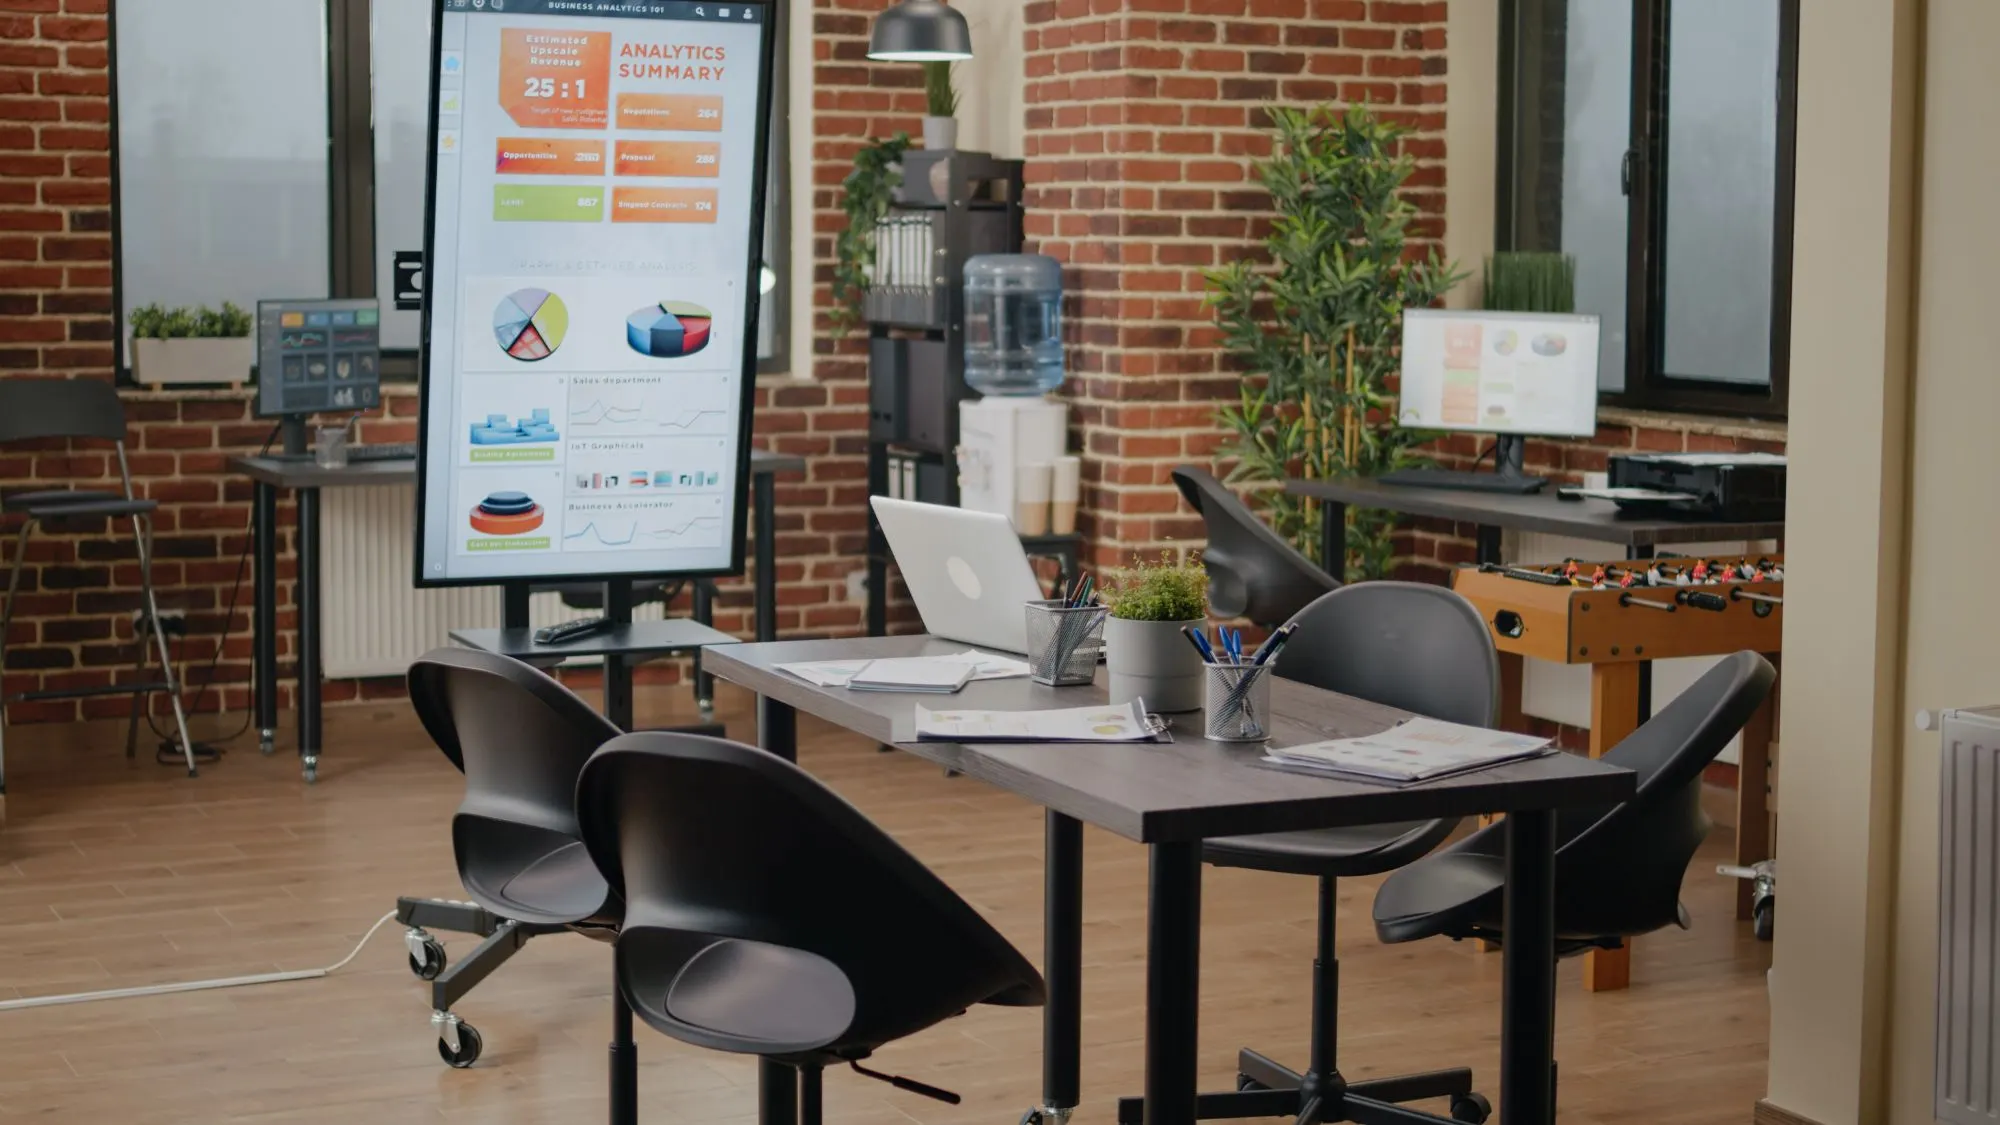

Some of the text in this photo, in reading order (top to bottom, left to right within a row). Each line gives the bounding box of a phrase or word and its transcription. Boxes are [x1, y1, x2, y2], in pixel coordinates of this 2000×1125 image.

[548, 2, 593, 10] BUSINESS
[597, 4, 647, 13] ANALYTICS
[526, 35, 588, 45] Estimated
[530, 46, 578, 56] Upscale
[620, 43, 726, 61] ANALYTICS
[530, 56, 581, 67] Revenue
[619, 63, 725, 80] SUMMARY
[524, 77, 555, 98] 25
[575, 79, 585, 99] 1
[503, 151, 558, 160] Opportunities
[620, 153, 656, 162] Proposal
[573, 376, 662, 385] Sales department
[591, 442, 644, 451] Graphicals
[569, 501, 674, 511] Business Accelerator
